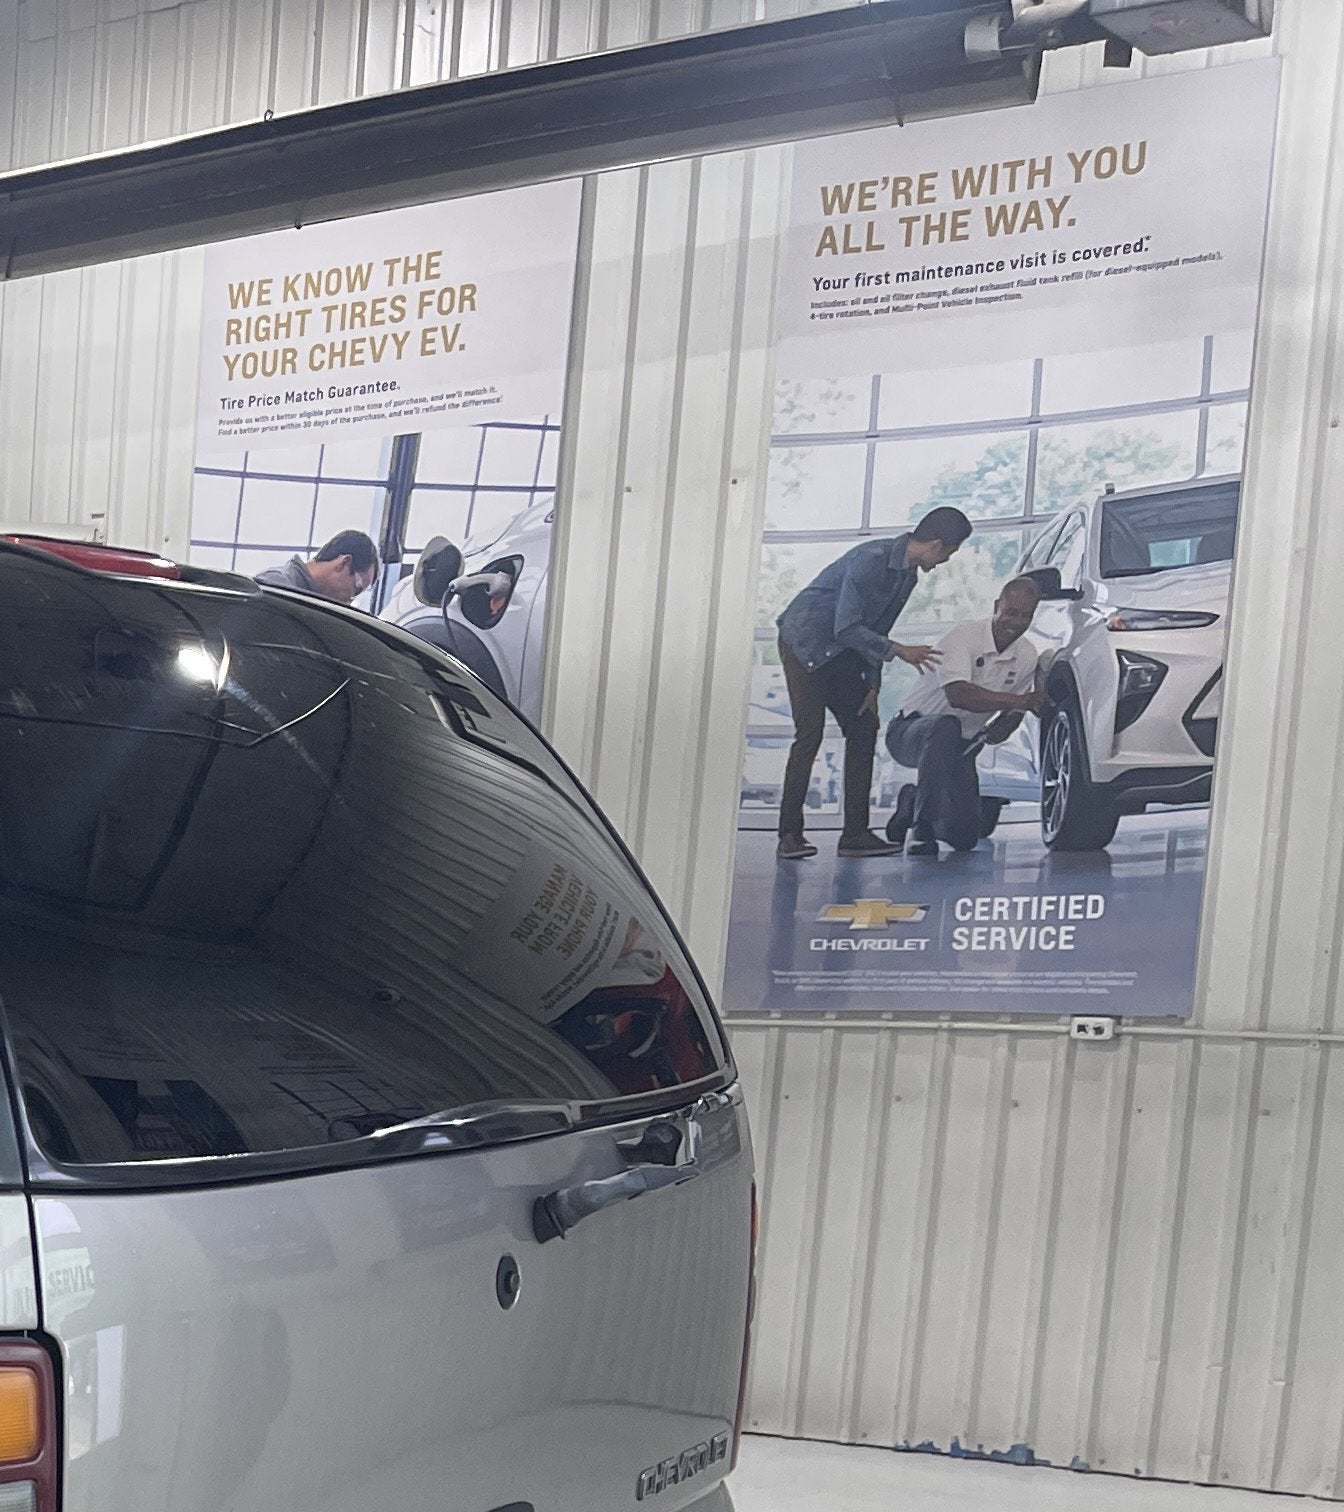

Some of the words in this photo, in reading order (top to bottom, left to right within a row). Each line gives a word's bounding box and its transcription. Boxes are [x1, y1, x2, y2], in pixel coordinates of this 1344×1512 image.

[820, 172, 940, 216] WE'RE
[951, 155, 1053, 199] WITH
[1067, 140, 1149, 184] YOU
[815, 222, 886, 258] ALL
[898, 208, 971, 248] THE
[984, 195, 1077, 236] WAY.
[227, 278, 273, 309] WE
[283, 262, 374, 303] KNOW
[384, 250, 443, 286] THE
[813, 276, 850, 292] Your
[855, 271, 891, 288] first
[895, 260, 1005, 284] maintenance
[1010, 252, 1047, 271] visit
[1052, 249, 1066, 265] is
[863, 296, 878, 304] and
[951, 285, 978, 296] diesel
[1039, 275, 1059, 285] tank
[225, 308, 312, 346] RIGHT
[321, 295, 406, 333] TIRES
[418, 283, 477, 319] FOR
[874, 305, 890, 315] and
[223, 346, 298, 381] YOUR
[308, 331, 411, 371] CHEVY
[421, 323, 466, 356] EV.
[218, 417, 243, 426] Provide
[276, 412, 298, 420] better
[299, 409, 323, 419] eligible
[325, 407, 343, 416] price
[367, 402, 382, 410] time
[384, 400, 392, 408] of
[464, 387, 487, 397] match
[220, 397, 244, 410] Tire
[248, 394, 281, 408] Price
[285, 387, 324, 404] Match
[328, 380, 400, 399] Guarantee.
[218, 428, 232, 436] Find
[239, 426, 260, 434] better
[261, 424, 278, 434] price
[280, 422, 301, 430] within
[313, 419, 329, 428] days
[331, 417, 338, 425] of
[389, 409, 402, 418] and
[421, 404, 446, 414] refund
[448, 402, 460, 410] the
[954, 894, 1105, 922] CERTIFIED
[809, 938, 930, 952] CHEVROLET
[951, 925, 1076, 952] SERVICE
